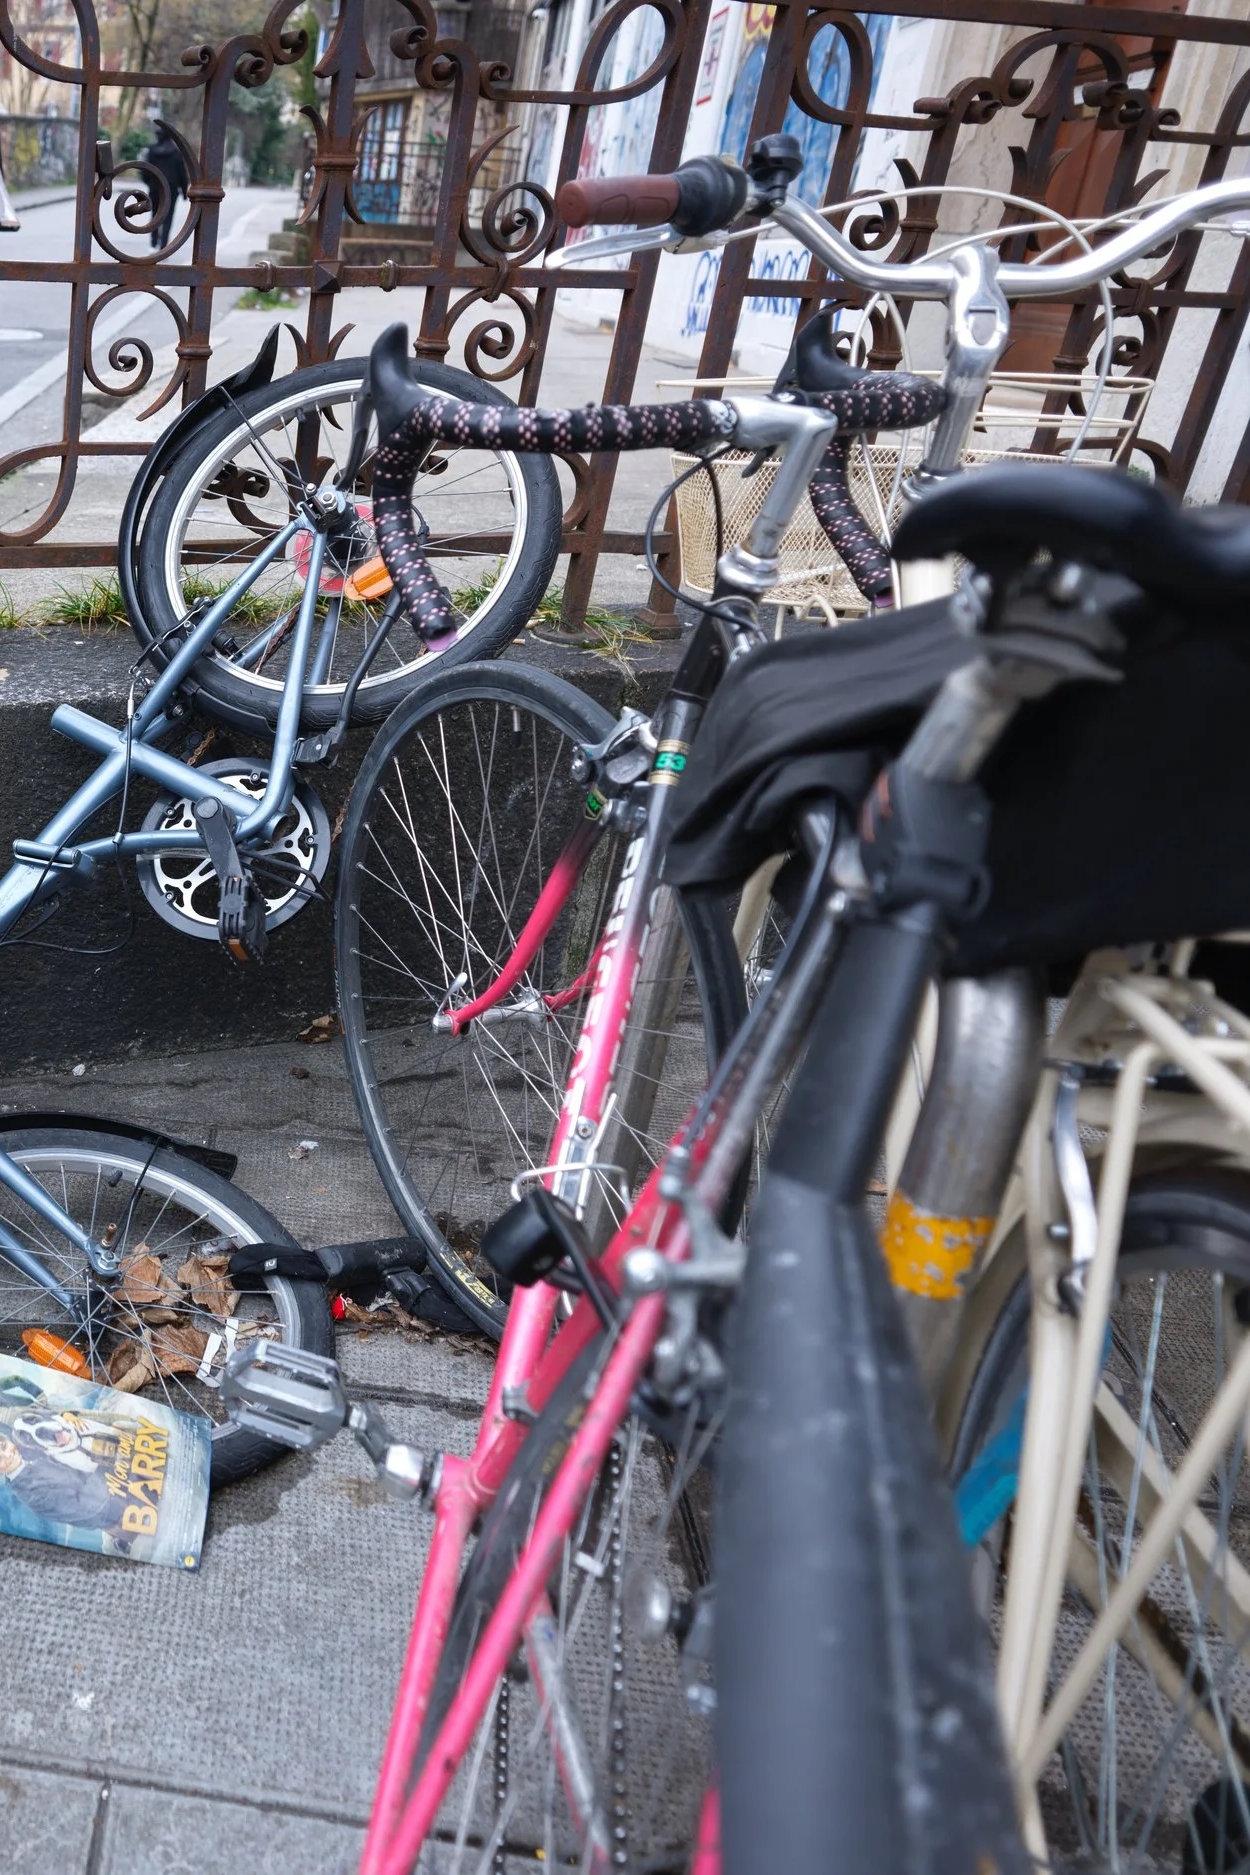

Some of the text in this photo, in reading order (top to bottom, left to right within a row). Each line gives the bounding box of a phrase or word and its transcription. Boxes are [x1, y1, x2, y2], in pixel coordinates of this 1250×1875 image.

[655, 752, 687, 771] 53
[104, 1460, 133, 1498] Mon
[121, 1415, 170, 1537] BARRY
